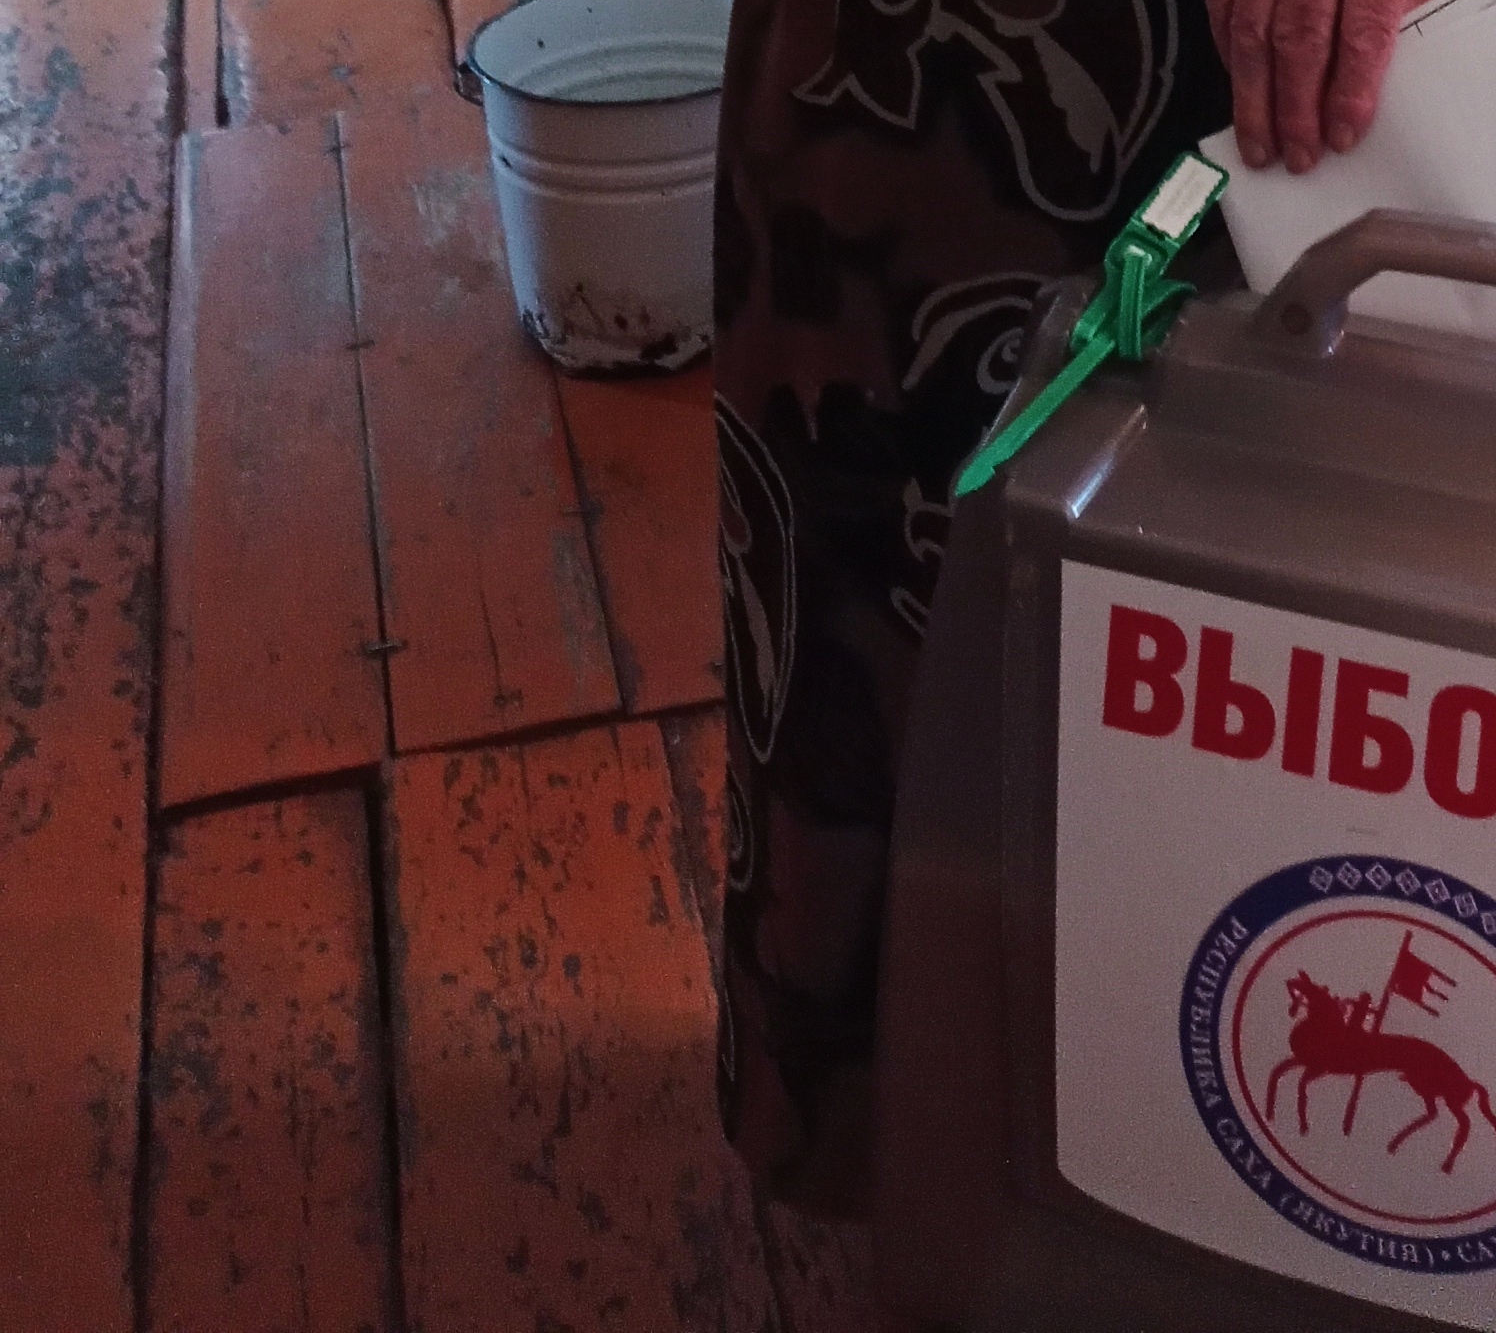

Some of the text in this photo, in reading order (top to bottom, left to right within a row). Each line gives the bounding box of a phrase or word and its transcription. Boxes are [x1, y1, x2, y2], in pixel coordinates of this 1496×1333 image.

[1188, 914, 1437, 1269] РЕСПУБЛИКА САХА (ЯКУТИЯ)
